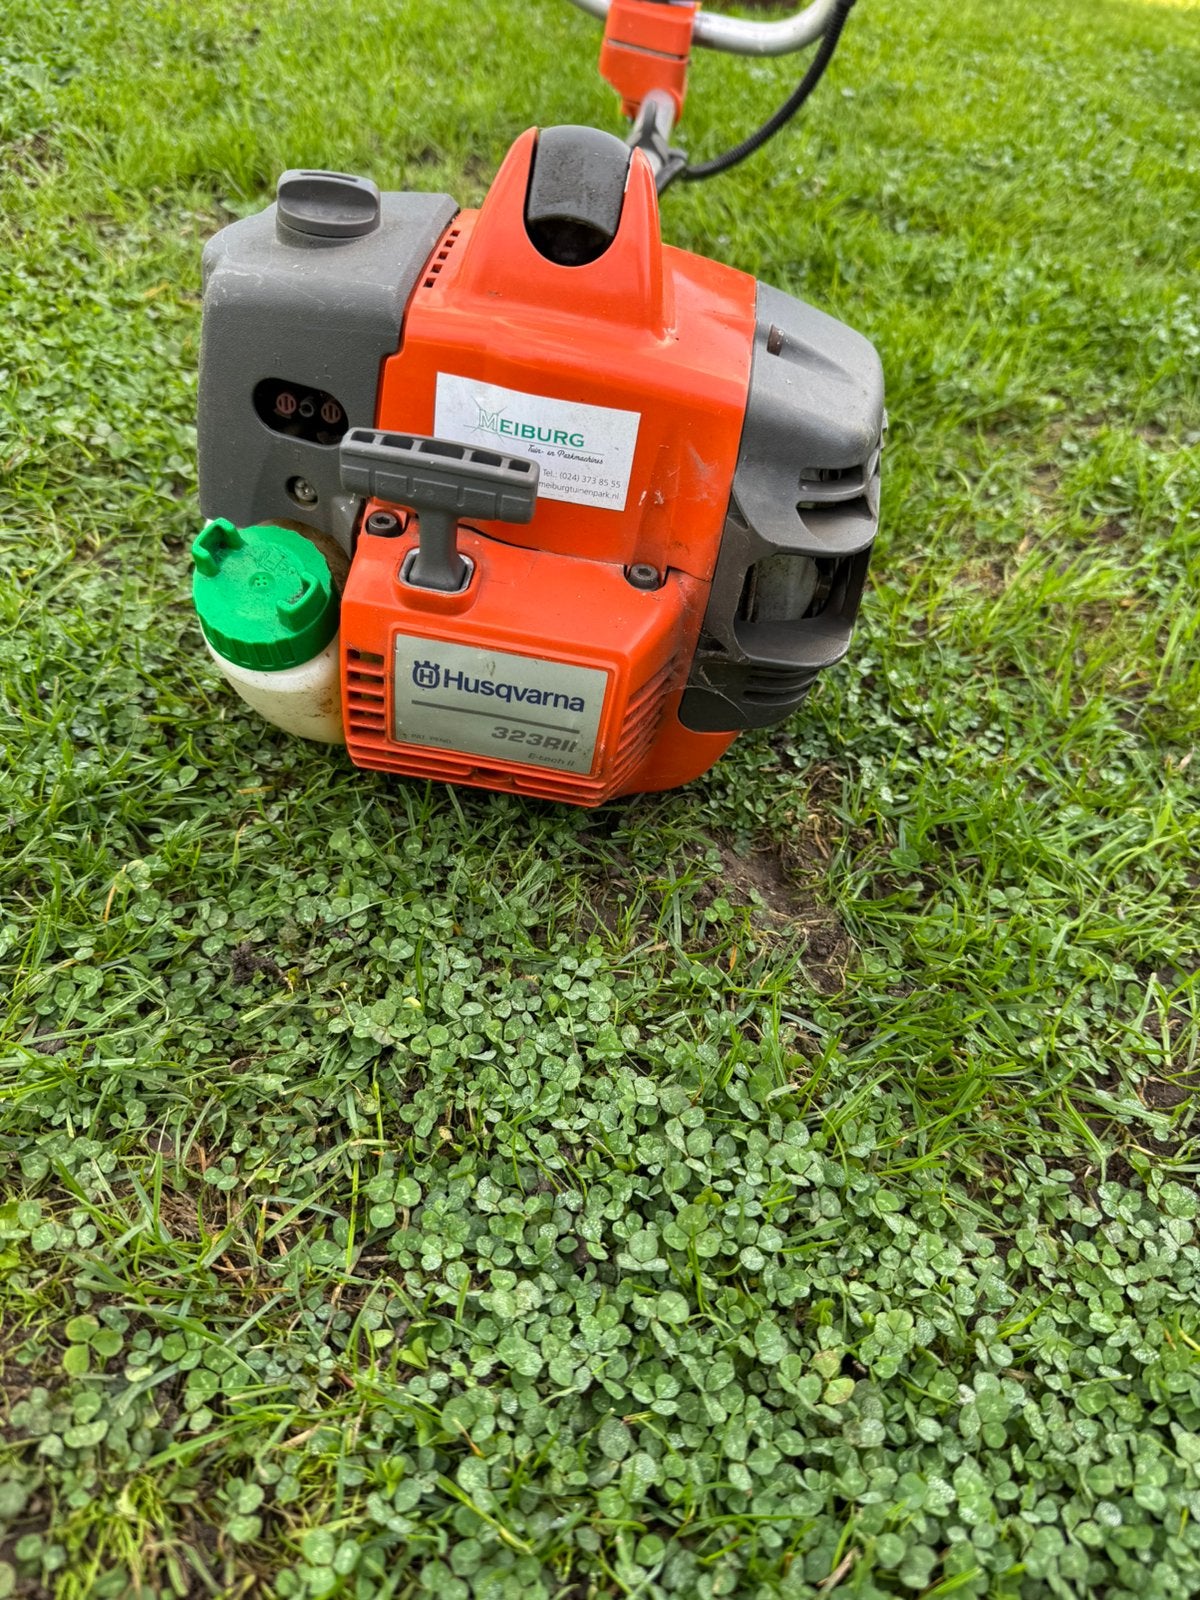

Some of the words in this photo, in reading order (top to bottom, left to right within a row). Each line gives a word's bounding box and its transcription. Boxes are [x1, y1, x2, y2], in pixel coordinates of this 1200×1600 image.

[479, 408, 585, 448] MEIBURG
[559, 471, 580, 482] (024)
[582, 475, 597, 485] 373
[598, 478, 609, 487] 85
[611, 479, 621, 489] 55
[443, 668, 585, 713] Husqvarna
[491, 726, 578, 753] 323RII
